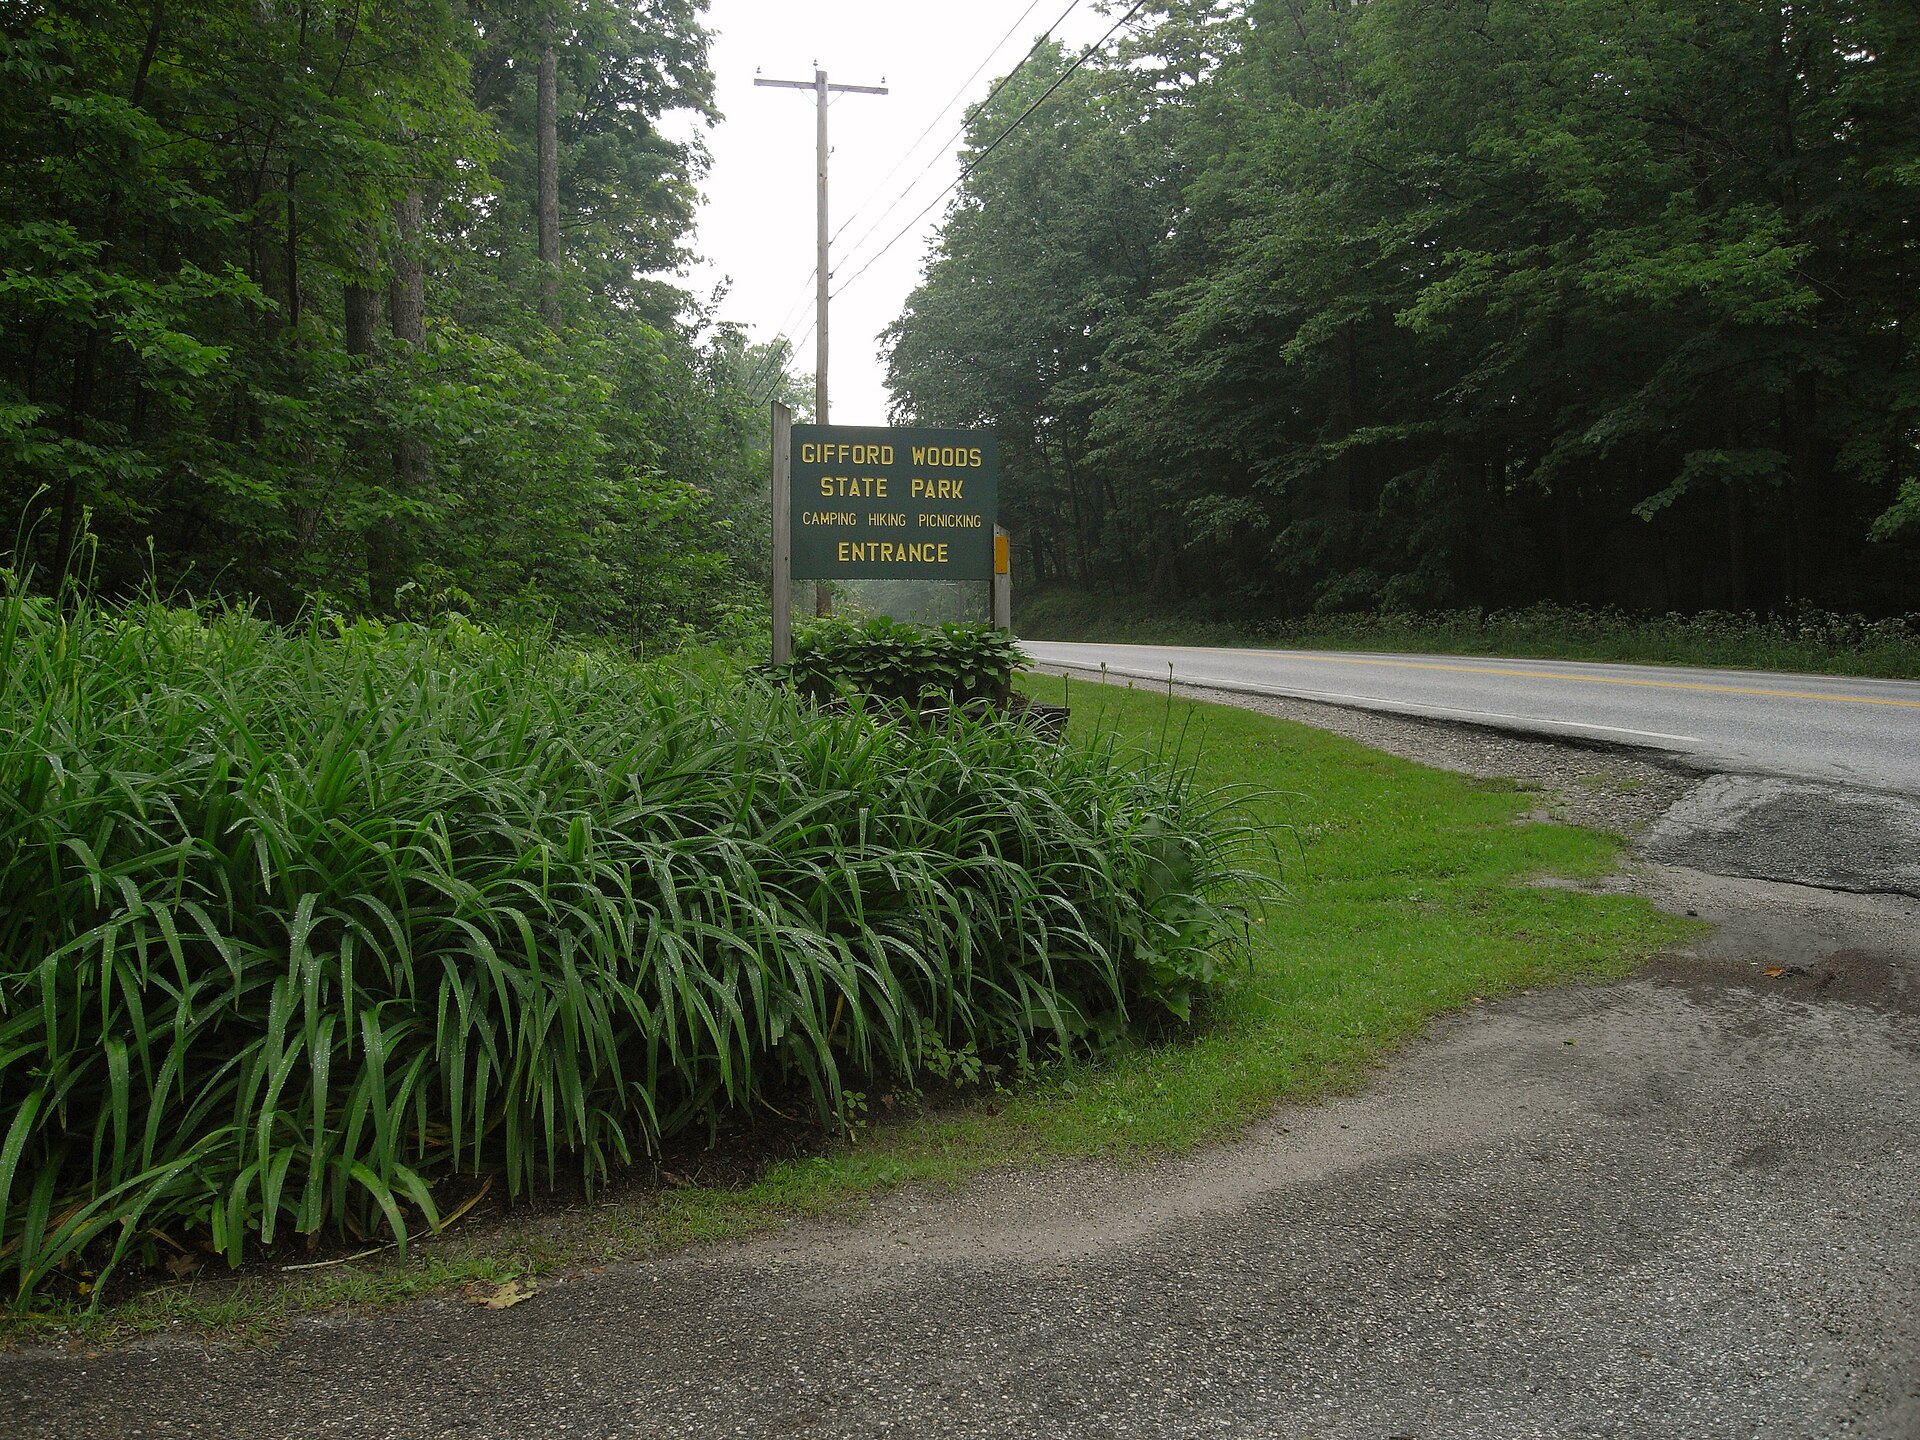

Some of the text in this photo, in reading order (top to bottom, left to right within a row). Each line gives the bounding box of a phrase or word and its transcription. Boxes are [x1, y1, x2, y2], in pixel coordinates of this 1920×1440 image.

[802, 443, 982, 467] GIFFORD WOODS
[820, 477, 964, 498] STATE PARK
[802, 512, 981, 528] CAMPING HIKING PICNICKING
[838, 542, 948, 562] ENTRANCE
